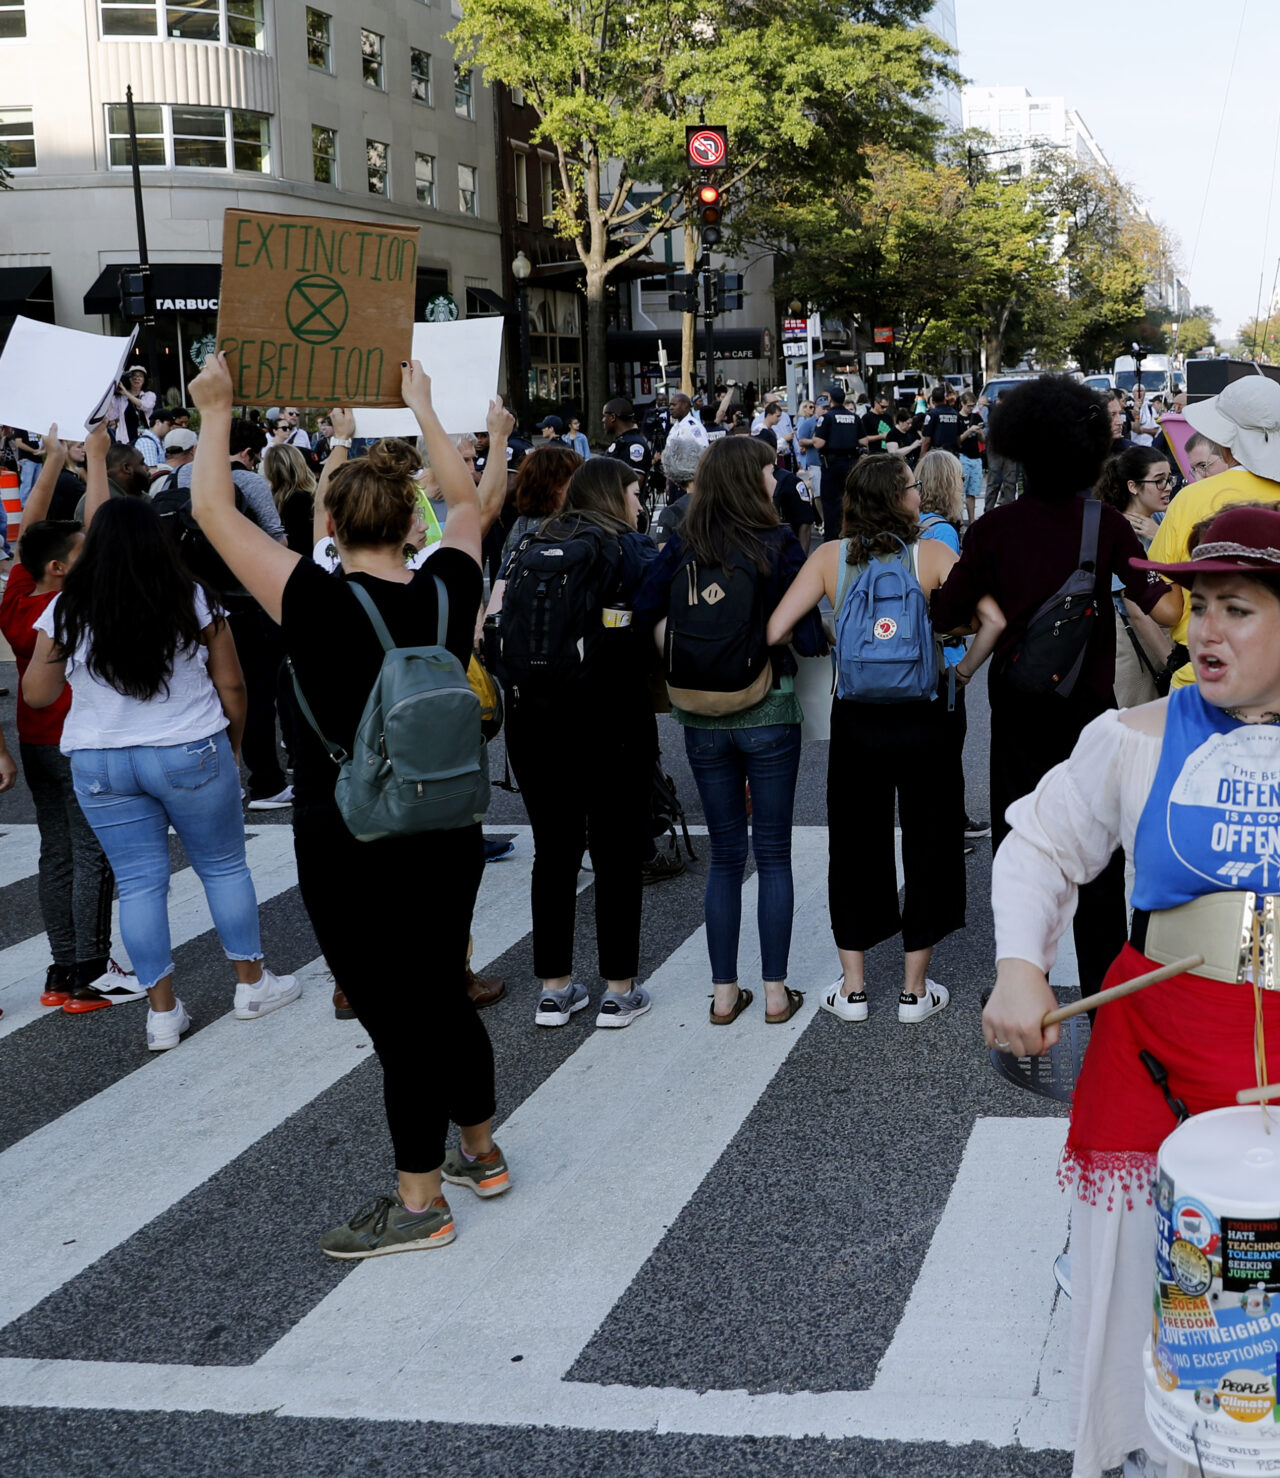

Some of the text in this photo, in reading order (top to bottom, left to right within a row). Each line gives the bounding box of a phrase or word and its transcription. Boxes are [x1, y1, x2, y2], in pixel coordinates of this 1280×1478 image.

[156, 298, 219, 310] TARBUC
[731, 350, 753, 358] CAFE
[1231, 764, 1256, 781] THE
[1225, 811, 1239, 822] IS
[1243, 813, 1253, 824] A
[1227, 1221, 1278, 1231] FIGHTING
[1227, 1230, 1255, 1240] HATE
[1227, 1241, 1280, 1251] TEACHING
[1227, 1260, 1272, 1270] SEEKING
[1227, 1269, 1270, 1279] JUSTICE
[1171, 1299, 1209, 1311] SOLAR
[1163, 1316, 1216, 1329] FREEDOM
[1192, 1338, 1278, 1367] EXCEPTIONS)
[1221, 1379, 1270, 1394] PEOPLES
[1221, 1396, 1271, 1408] Climate
[1199, 1451, 1235, 1469] RESIST
